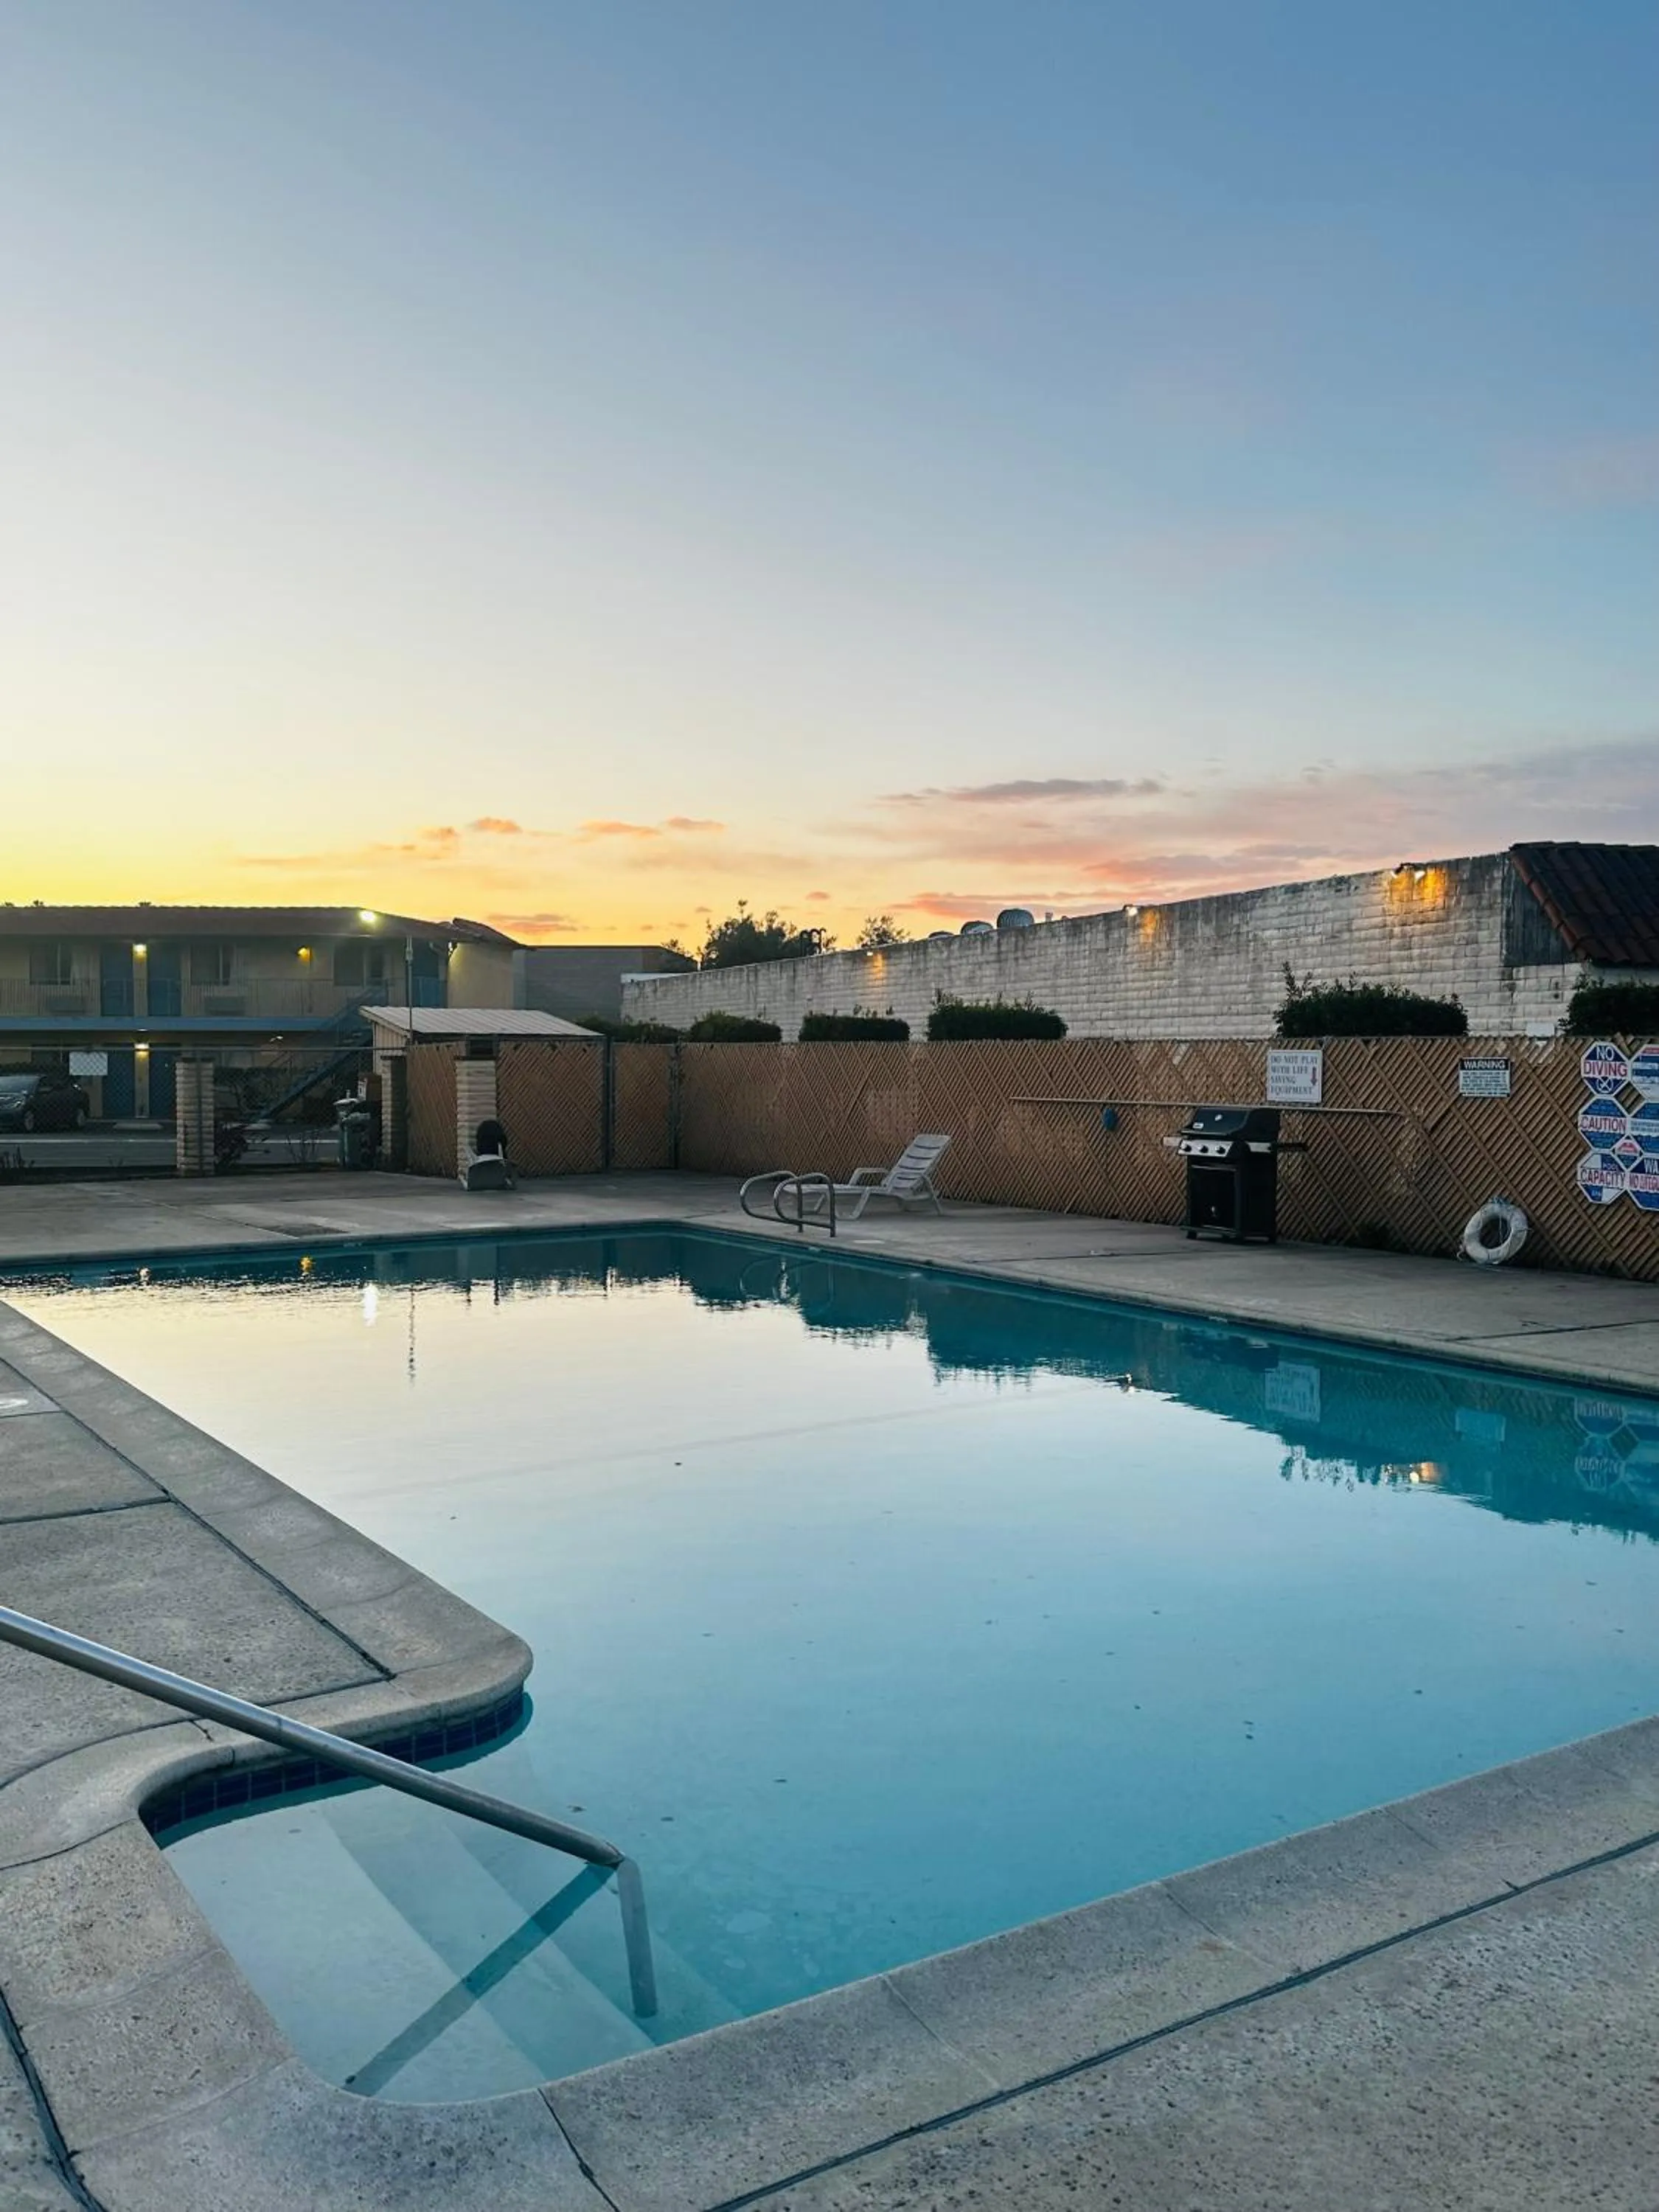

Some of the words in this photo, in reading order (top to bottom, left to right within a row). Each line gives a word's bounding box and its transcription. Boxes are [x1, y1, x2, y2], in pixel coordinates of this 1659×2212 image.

[1270, 1055, 1281, 1063] DO
[1284, 1055, 1298, 1064] NOT
[1301, 1055, 1318, 1065] PLAY
[1596, 1046, 1614, 1060] NO
[1293, 1066, 1308, 1074] LIFE
[1464, 1060, 1506, 1069] WARNING
[1584, 1062, 1627, 1077] DIVING
[1582, 1116, 1626, 1133] CAUTION
[1580, 1168, 1625, 1188] CAPACITY
